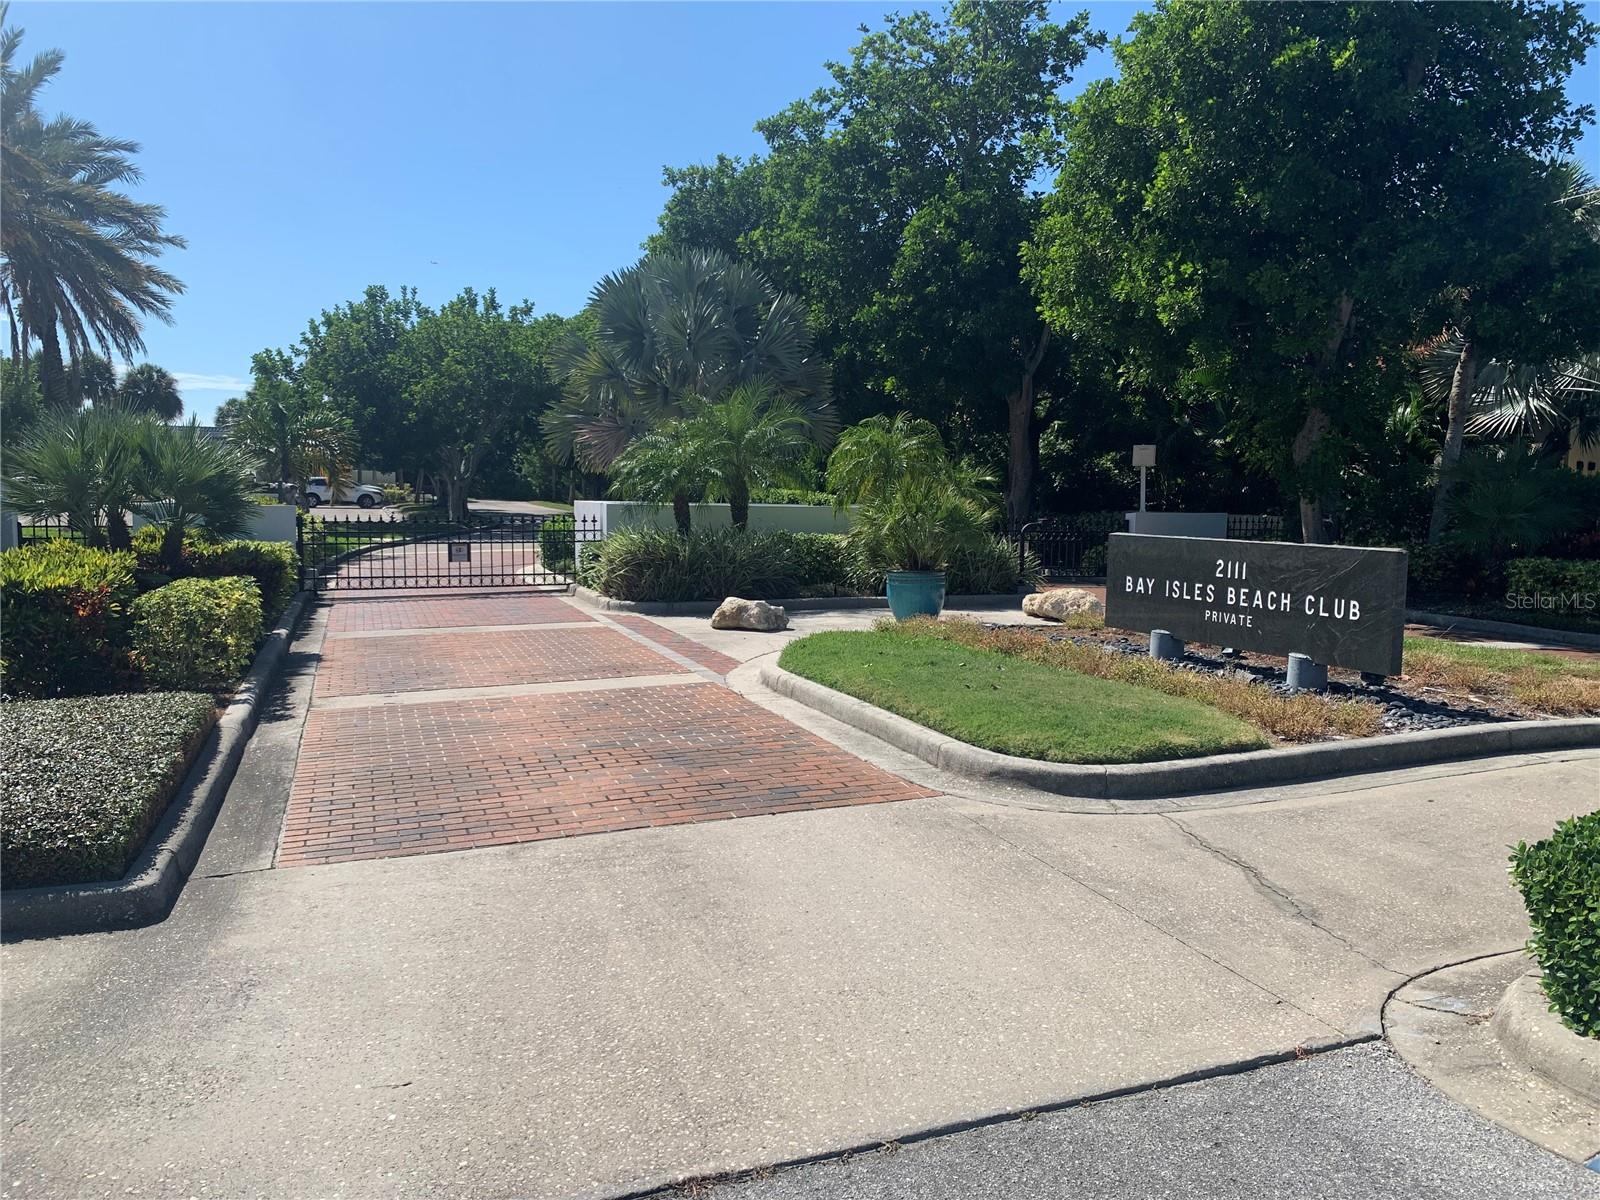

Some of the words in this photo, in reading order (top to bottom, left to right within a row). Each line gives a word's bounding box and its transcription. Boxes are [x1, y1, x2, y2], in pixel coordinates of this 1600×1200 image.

[1215, 558, 1247, 580] 2111
[1125, 575, 1155, 595] BAY
[1165, 579, 1215, 603] ISLES
[1226, 586, 1291, 612] BEACH
[1304, 594, 1361, 621] CLUB
[1204, 609, 1253, 628] PRIVATE
